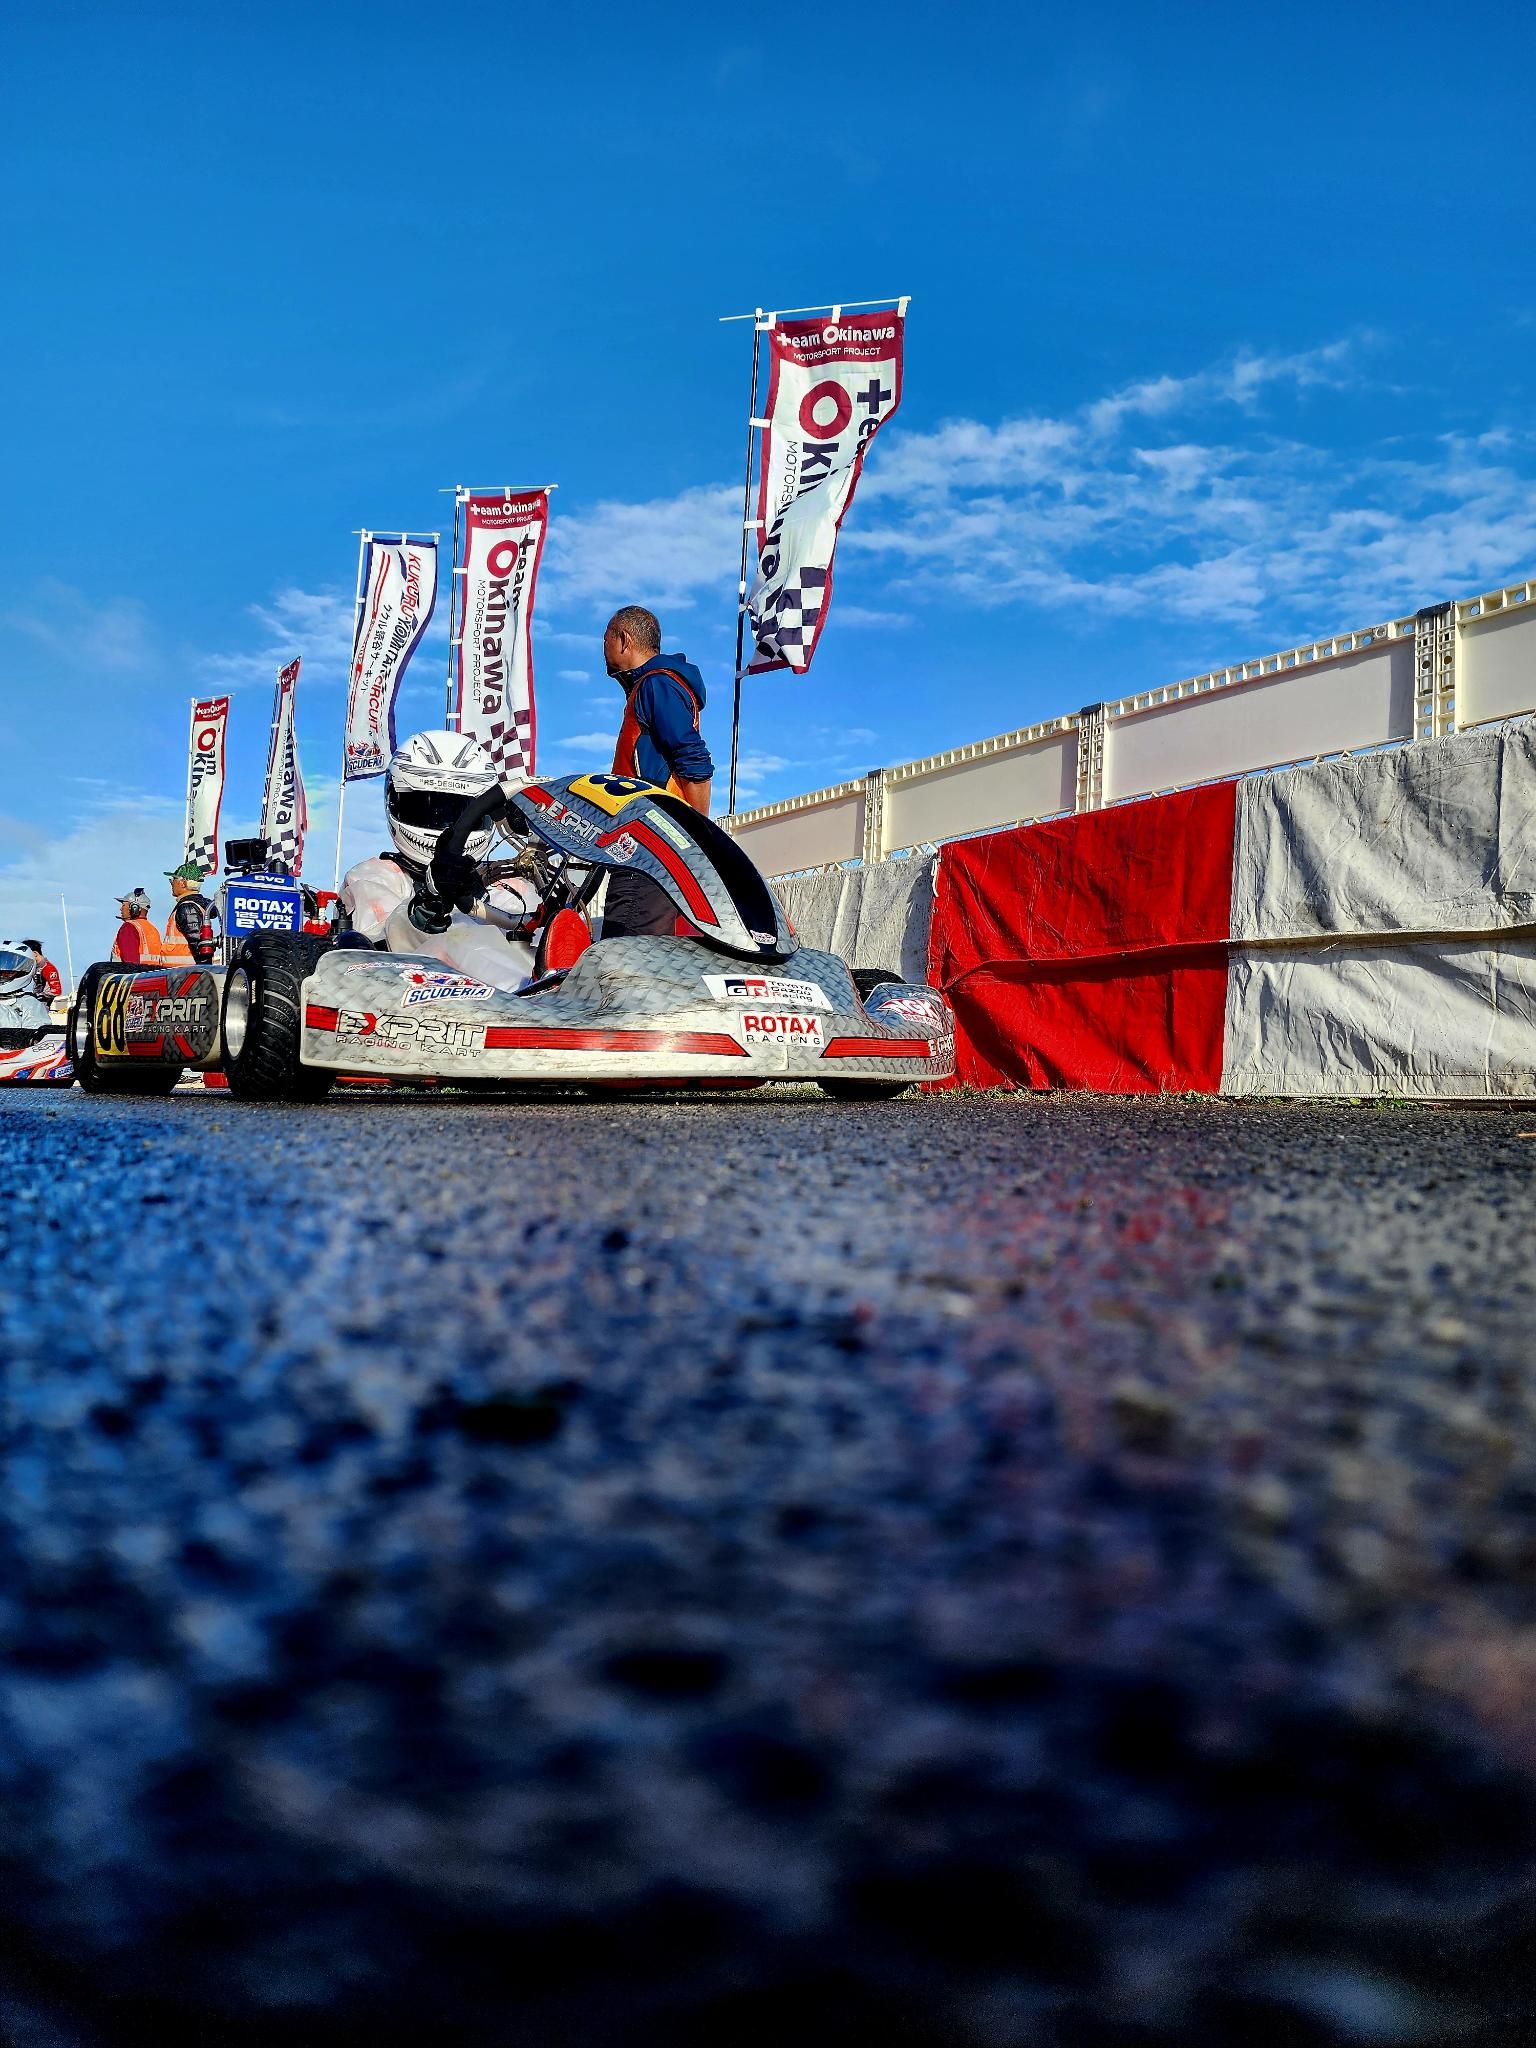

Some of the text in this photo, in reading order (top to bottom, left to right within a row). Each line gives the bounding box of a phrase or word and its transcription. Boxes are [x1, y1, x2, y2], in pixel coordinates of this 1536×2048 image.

[776, 325, 895, 348] team Okinawa
[793, 346, 881, 362] MOTORSPORT PROJECT
[470, 503, 501, 516] team
[482, 539, 519, 715] Okinawa
[472, 579, 486, 704] MOTORSPORT PROJECT
[367, 674, 384, 733] CIRCUIT
[545, 800, 605, 843] EXPRIT
[234, 897, 294, 914] ROTAX
[235, 911, 259, 919] 125
[408, 987, 488, 1003] SCUDERIA
[724, 979, 813, 997] GR TOYOTA
[772, 991, 813, 1002] Racing
[96, 977, 131, 1052] 88
[143, 998, 208, 1023] EXPRIT
[338, 1009, 485, 1048] EXPRIT
[743, 1015, 820, 1036] ROTAX
[335, 1035, 482, 1058] RACING KART
[746, 1034, 821, 1045] RACING
